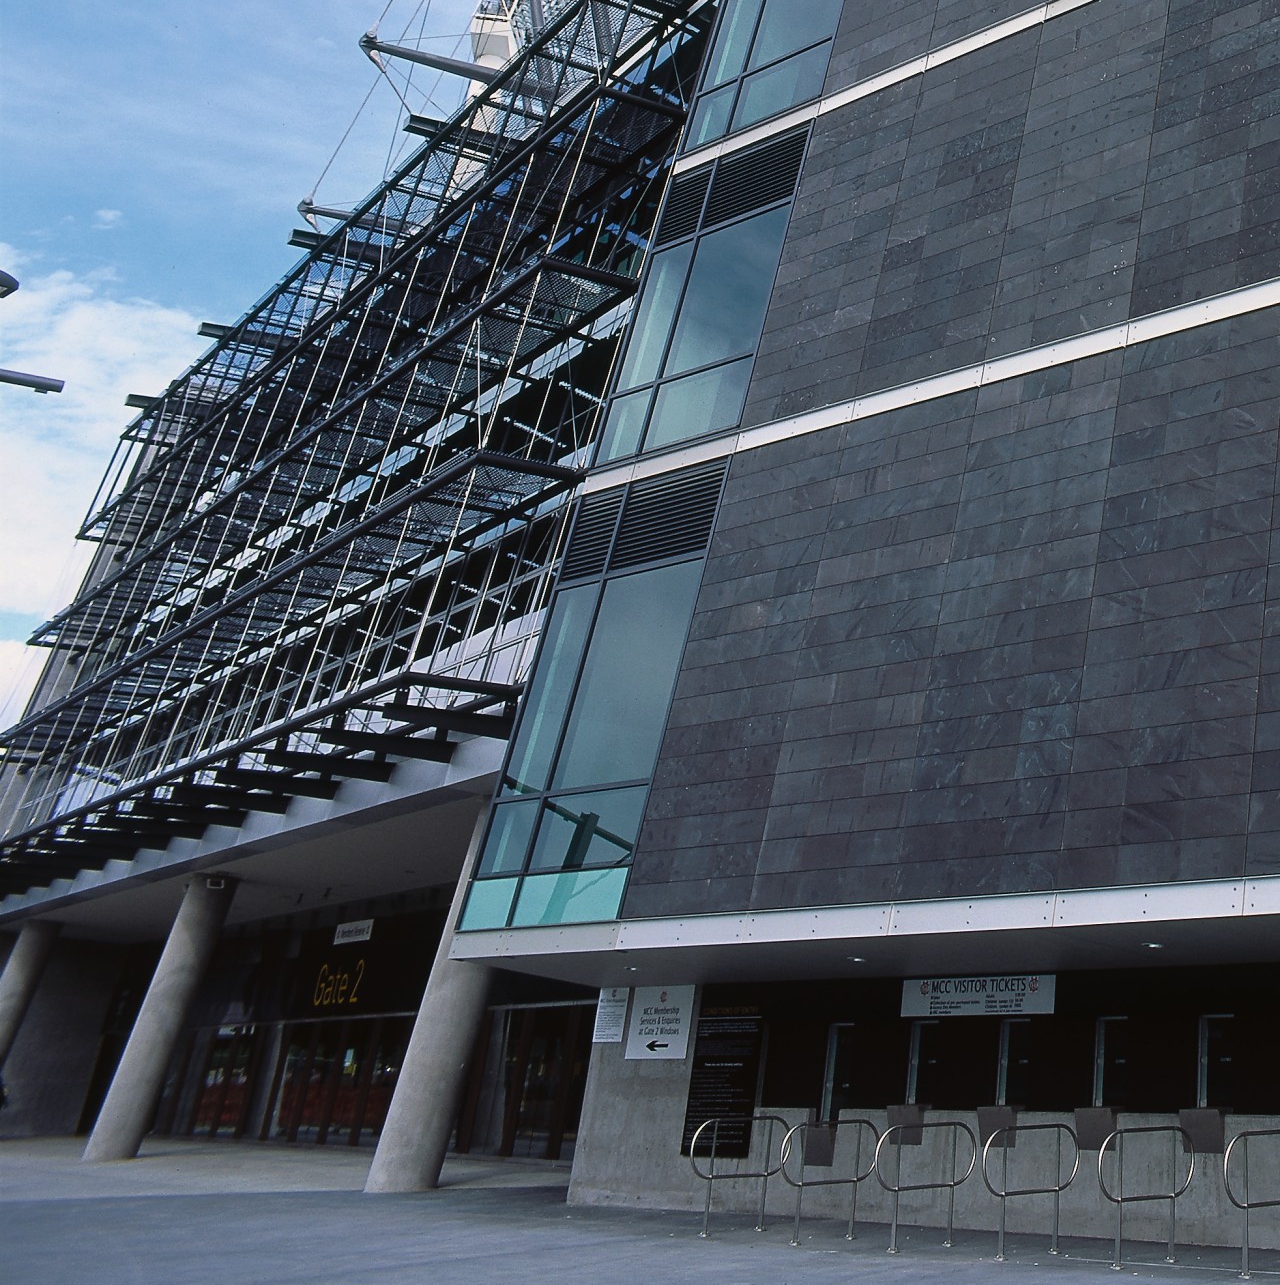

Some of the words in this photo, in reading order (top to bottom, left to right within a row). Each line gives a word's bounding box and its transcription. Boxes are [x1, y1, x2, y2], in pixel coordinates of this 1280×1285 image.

[313, 964, 349, 1006] Gate
[349, 958, 365, 1003] 2
[931, 980, 951, 994] MCC
[953, 979, 987, 993] VISITOR
[990, 978, 1027, 992] TICKETS
[643, 1007, 654, 1015] MCC
[654, 1006, 680, 1016] Membership
[640, 1016, 657, 1025] Services
[661, 1016, 680, 1026] Enquiries
[644, 1027, 655, 1035] Gate
[660, 1026, 680, 1035] Windows
